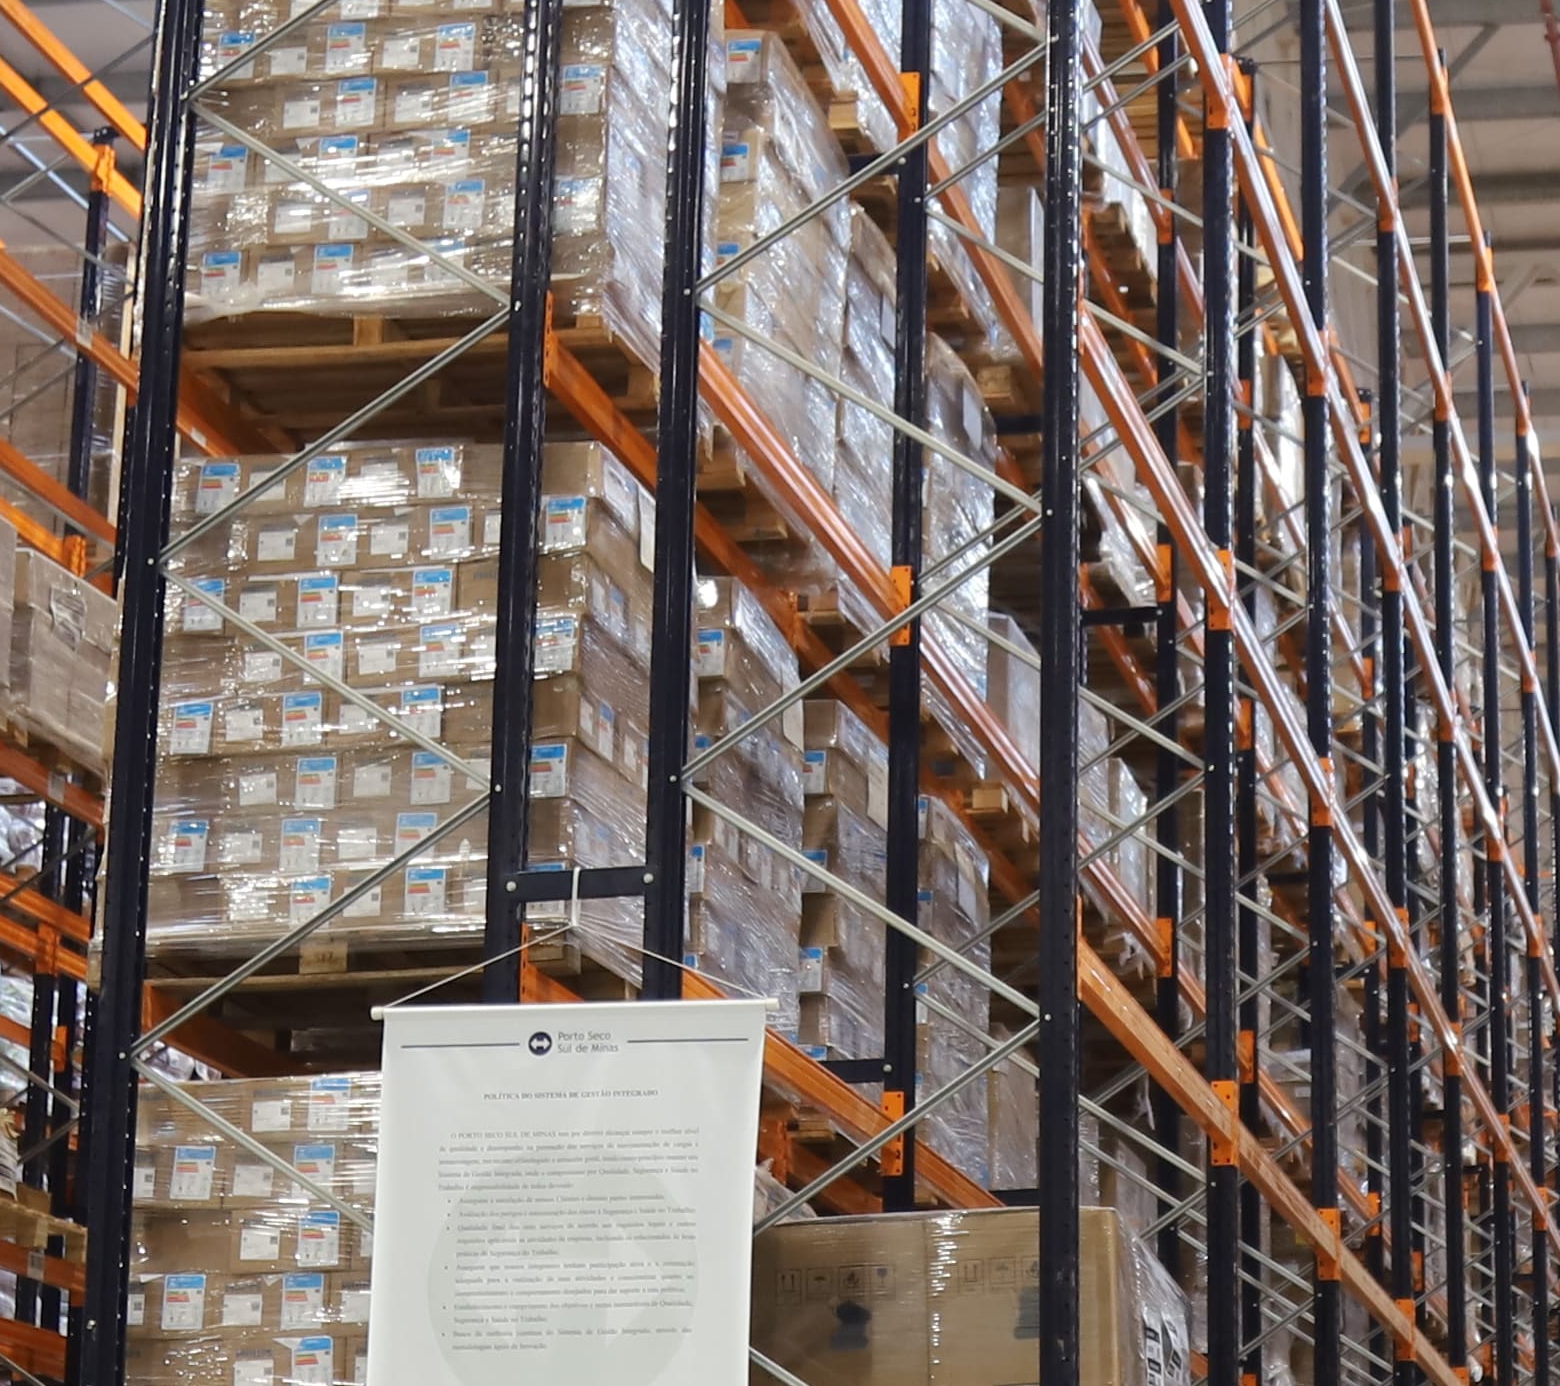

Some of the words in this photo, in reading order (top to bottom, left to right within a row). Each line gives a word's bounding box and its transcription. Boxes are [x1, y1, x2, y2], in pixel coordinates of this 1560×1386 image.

[558, 1031, 584, 1042] Porto
[587, 1030, 611, 1041] Seco
[557, 1043, 573, 1054] Sul
[575, 1043, 588, 1053] de
[591, 1042, 619, 1053] Minas
